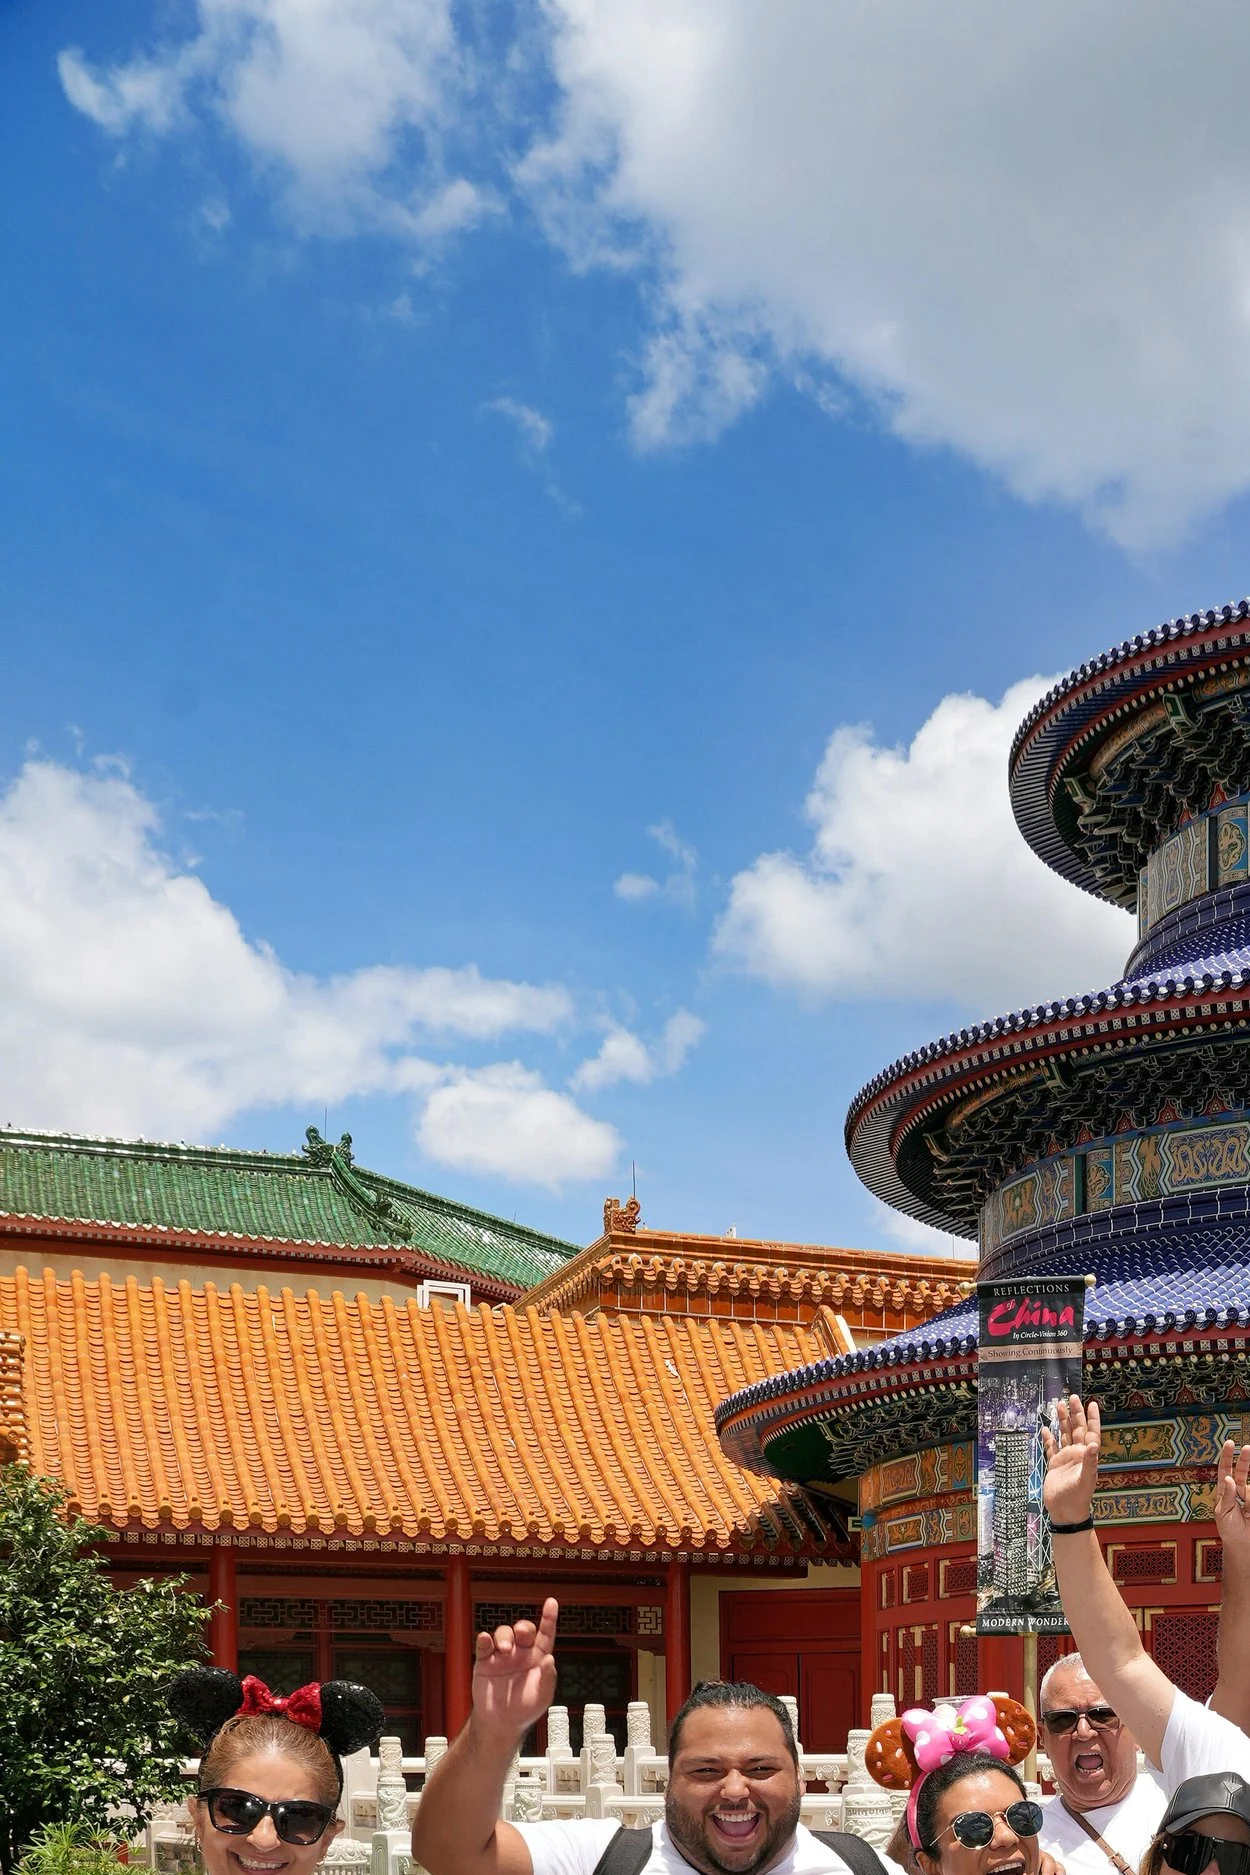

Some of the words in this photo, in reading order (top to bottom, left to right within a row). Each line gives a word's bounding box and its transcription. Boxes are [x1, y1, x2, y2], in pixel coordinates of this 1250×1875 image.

[993, 1284, 1070, 1297] REFLECTIONS
[988, 1297, 1075, 1336] China
[1020, 1330, 1056, 1339] Circle-Vision
[1057, 1329, 1068, 1337] 360
[987, 1348, 1021, 1358] Showing
[1022, 1346, 1073, 1357] Continuously
[981, 1617, 1024, 1627] MODERN
